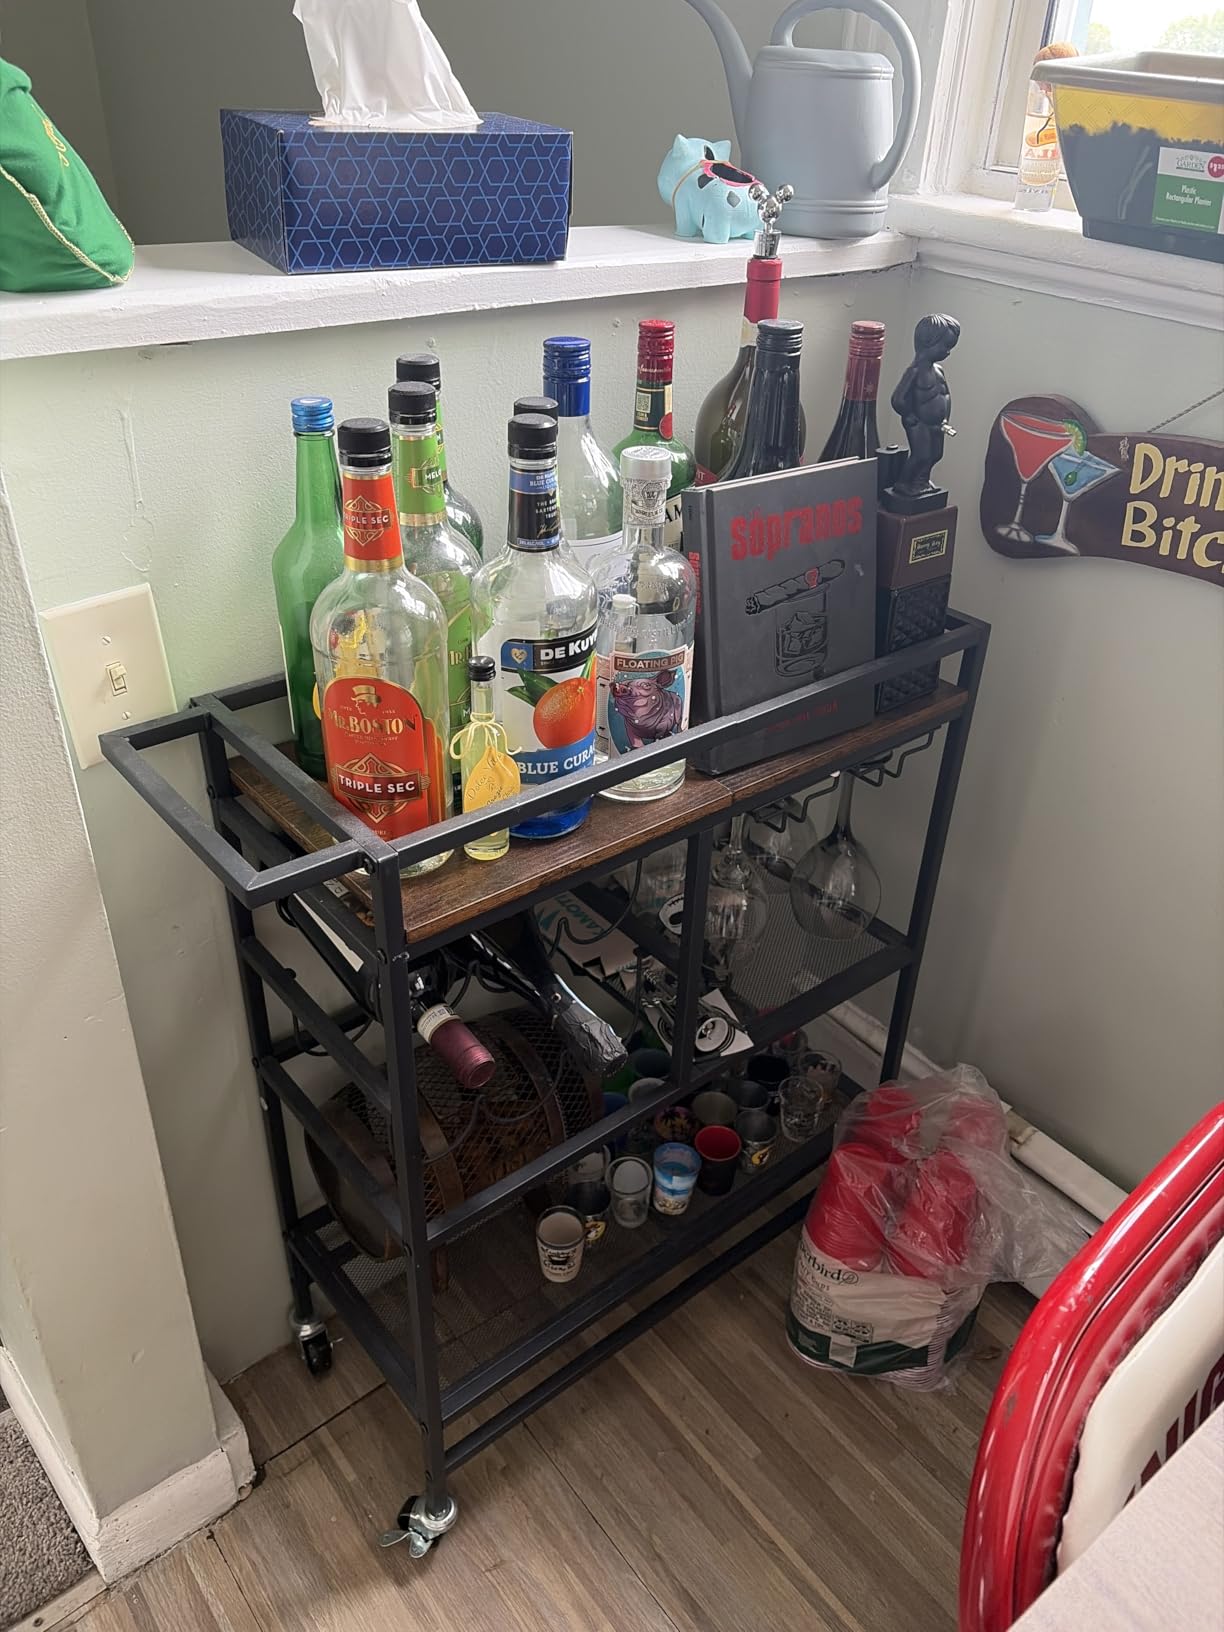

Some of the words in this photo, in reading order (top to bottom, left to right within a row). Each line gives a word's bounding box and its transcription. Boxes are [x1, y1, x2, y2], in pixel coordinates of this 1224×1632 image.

[371, 515, 389, 525] SEC
[1121, 501, 1224, 574] Bitc
[540, 647, 566, 662] DE
[617, 658, 668, 669] FLOATING
[670, 653, 684, 665] PIG
[518, 761, 559, 776] BLUE
[338, 774, 382, 794] TRIPLE
[387, 781, 416, 793] SEC
